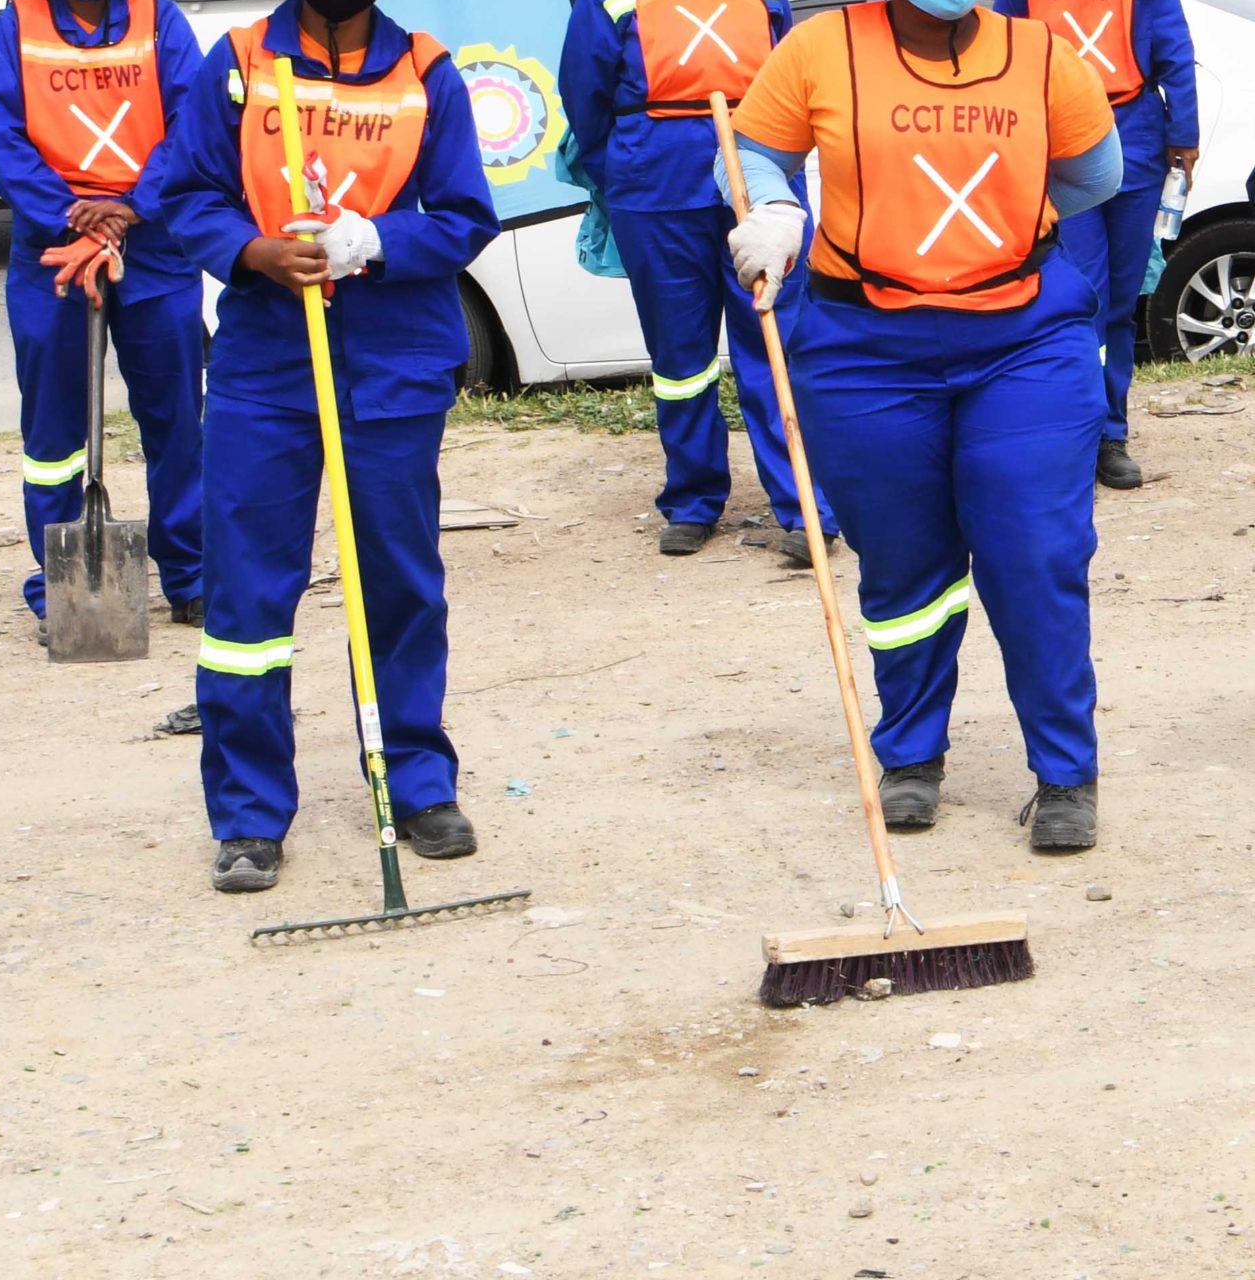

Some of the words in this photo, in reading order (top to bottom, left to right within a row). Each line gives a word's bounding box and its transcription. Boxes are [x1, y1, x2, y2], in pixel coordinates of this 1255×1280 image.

[49, 68, 88, 92] CCT
[93, 64, 142, 90] EPWP
[263, 105, 317, 136] CT
[322, 105, 393, 141] EPWP
[891, 104, 944, 133] CCT
[953, 105, 1019, 138] EPWP
